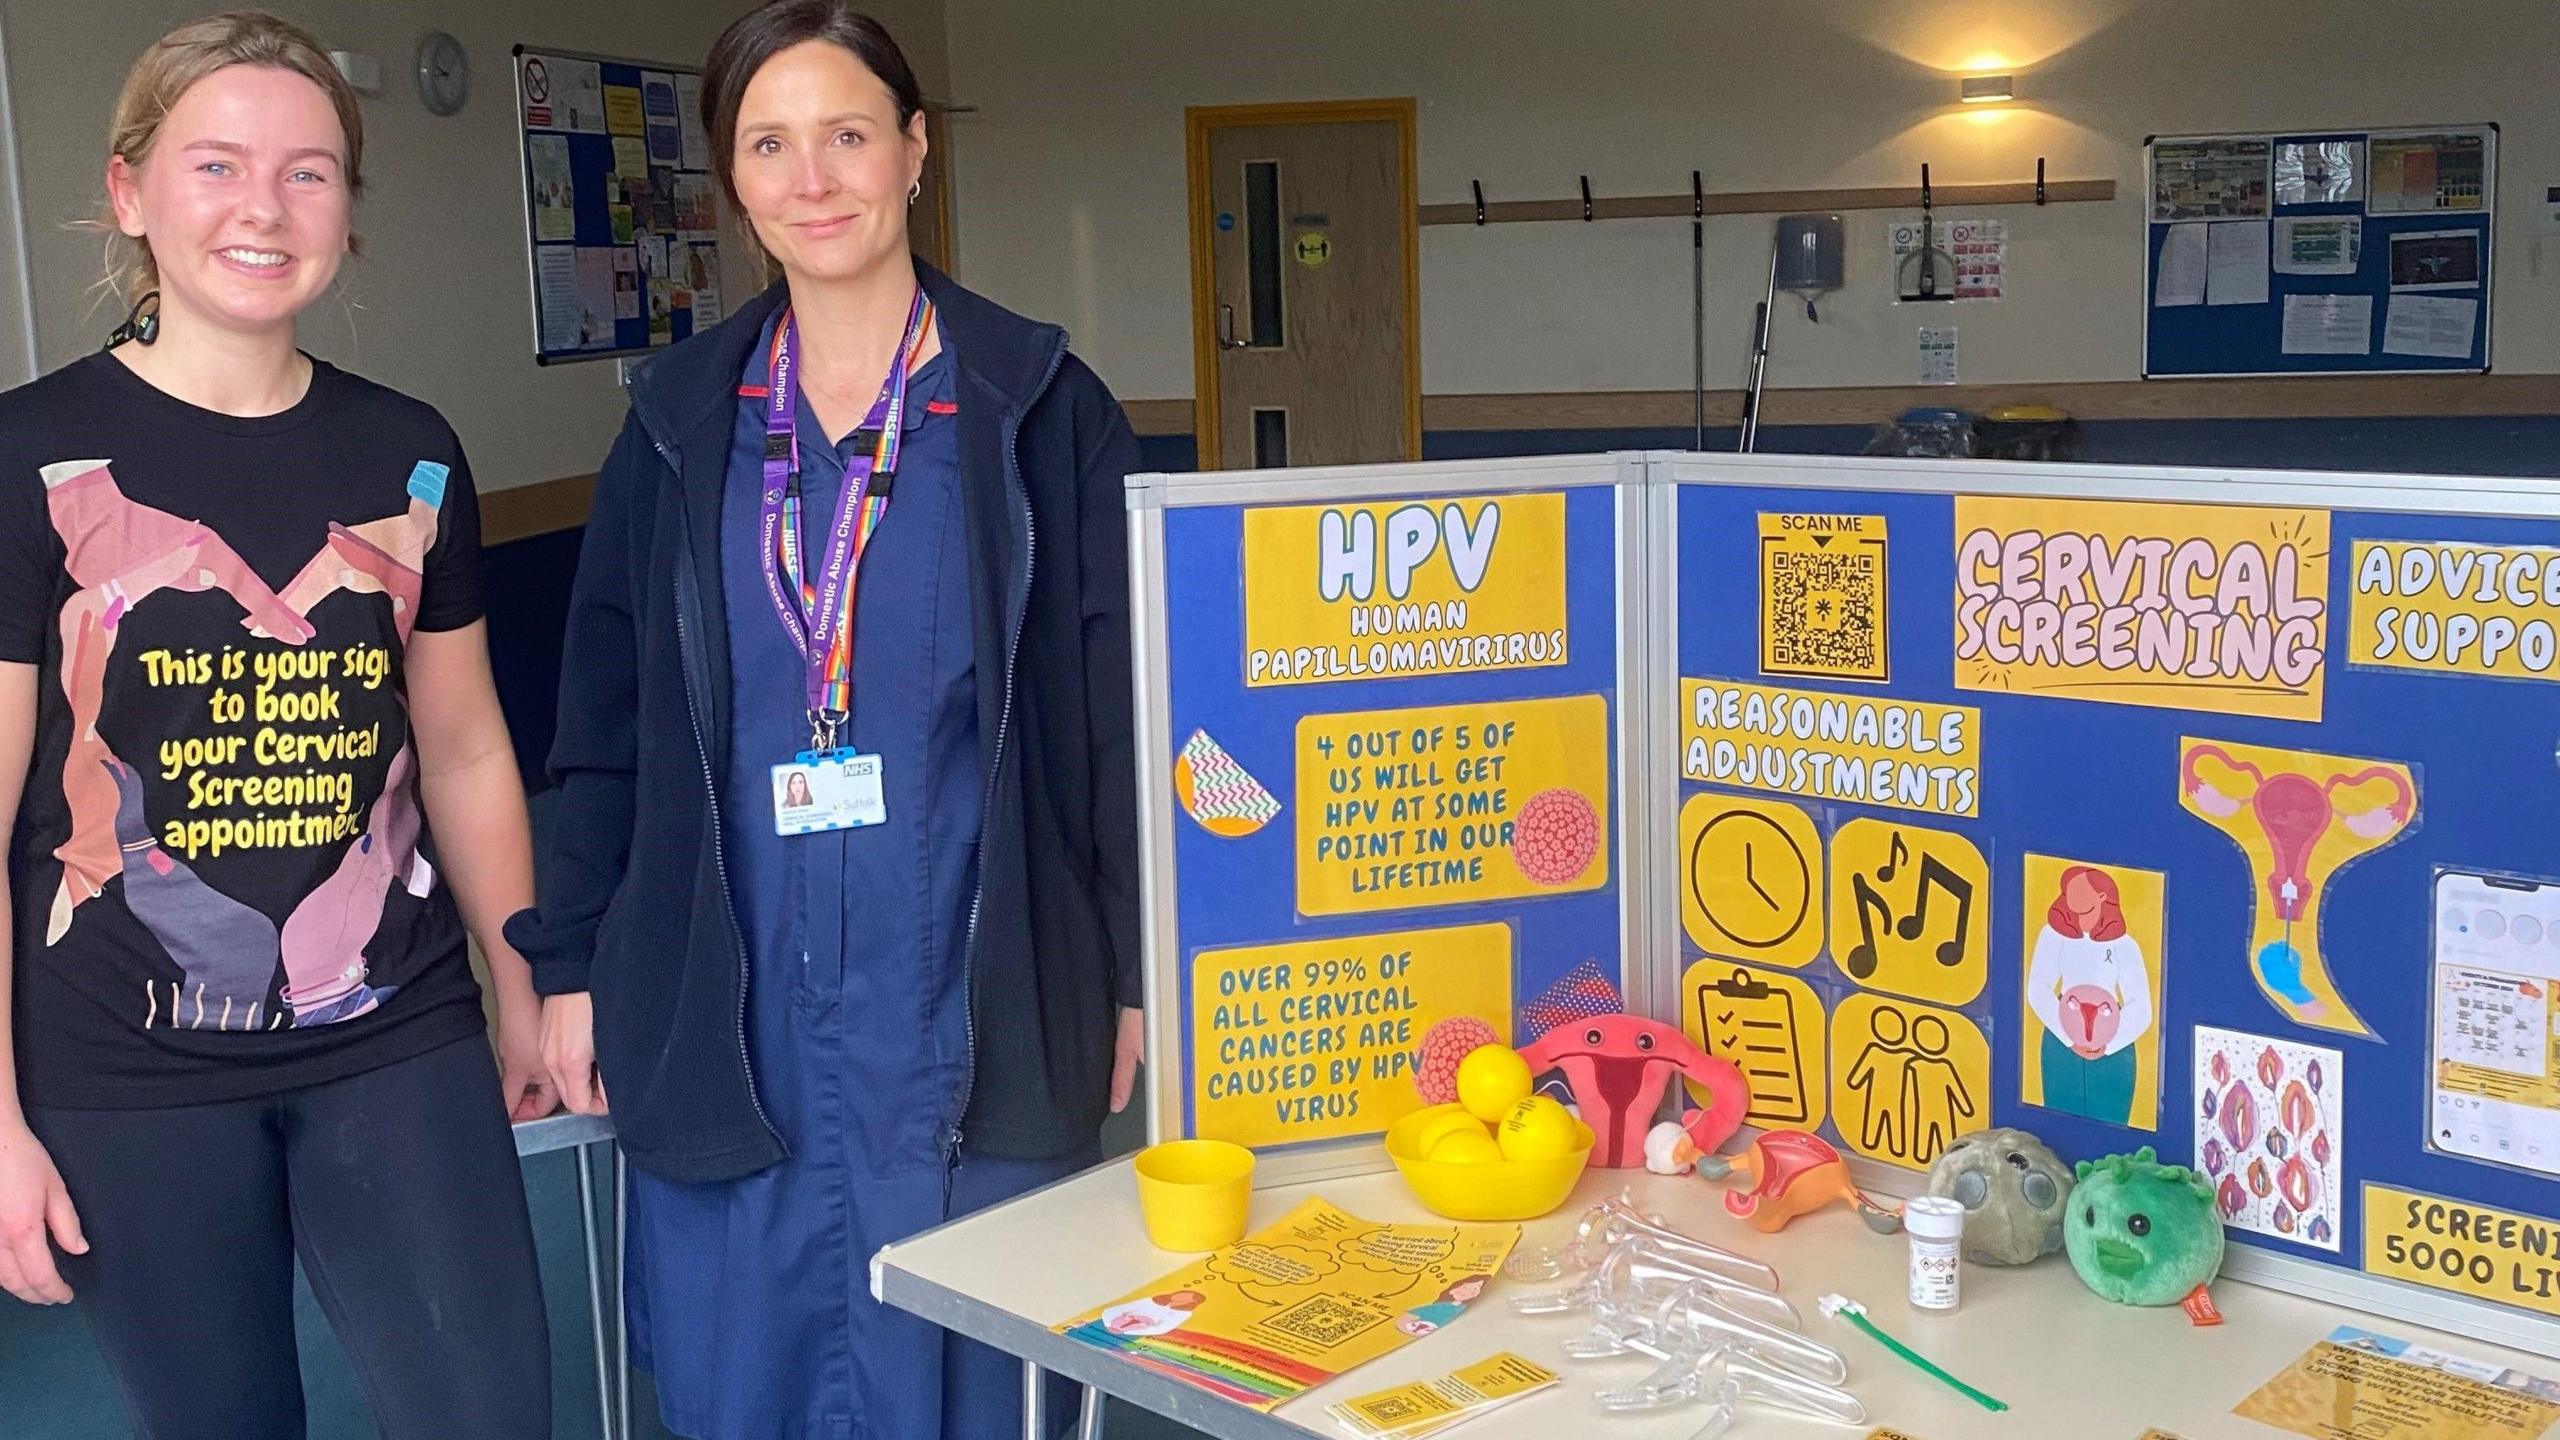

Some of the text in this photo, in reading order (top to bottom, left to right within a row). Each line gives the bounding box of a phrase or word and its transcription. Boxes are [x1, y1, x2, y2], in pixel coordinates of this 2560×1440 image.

[775, 356, 790, 412] Champion
[885, 398, 900, 440] NURSE
[764, 513, 777, 569] Domestic
[1781, 514, 1863, 532] SCAN ME
[783, 529, 798, 574] NURSE
[814, 476, 862, 641] Domestic Abuse Champion
[1318, 500, 1501, 602] HPV
[766, 572, 785, 610] Abuse
[1957, 528, 2325, 624] CERVICAL
[1350, 600, 1468, 637] HUMAN
[1956, 594, 2325, 687] SCREENING
[2373, 607, 2560, 672] SUPPO
[139, 649, 213, 687] This
[222, 645, 246, 680] is
[254, 650, 337, 692] your
[1250, 629, 1564, 682] PAPILLOMAVIRIRUS
[208, 684, 340, 723] to book
[1695, 686, 1965, 755] REASONABLE
[160, 721, 379, 780] your Cervical
[1317, 721, 1516, 761] 4 OUT OF 5 OF
[187, 769, 353, 814] Screening
[844, 762, 873, 777] NHS
[1329, 755, 1506, 793] US WILL GET
[1687, 736, 1975, 813] ADJUSTMENTS
[1326, 789, 1508, 827] HPV AT SOME
[1317, 820, 1515, 862] POINT IN OUR
[1352, 857, 1483, 893] LIFETIME
[1219, 951, 1413, 997] OVER 99% OF
[1213, 985, 1418, 1031] ALL CERVICAL
[1220, 1018, 1411, 1065] CANCERS ARE
[1207, 1051, 1424, 1100] CAUSED BY HPV
[1276, 1090, 1360, 1125] VIRUS
[2386, 1234, 2560, 1297] 5000 LI
[1338, 1292, 1371, 1304] SCAN
[2326, 1352, 2530, 1412] TO ACCESSING CERVICAL
[2333, 1345, 2392, 1365] WIPING
[2395, 1362, 2430, 1375] OUT
[2306, 1365, 2525, 1428] LIVING WITH DISABILITIES
[2315, 1359, 2519, 1418] SCREENING FOR PEOPLE
[2385, 1397, 2419, 1411] Very
